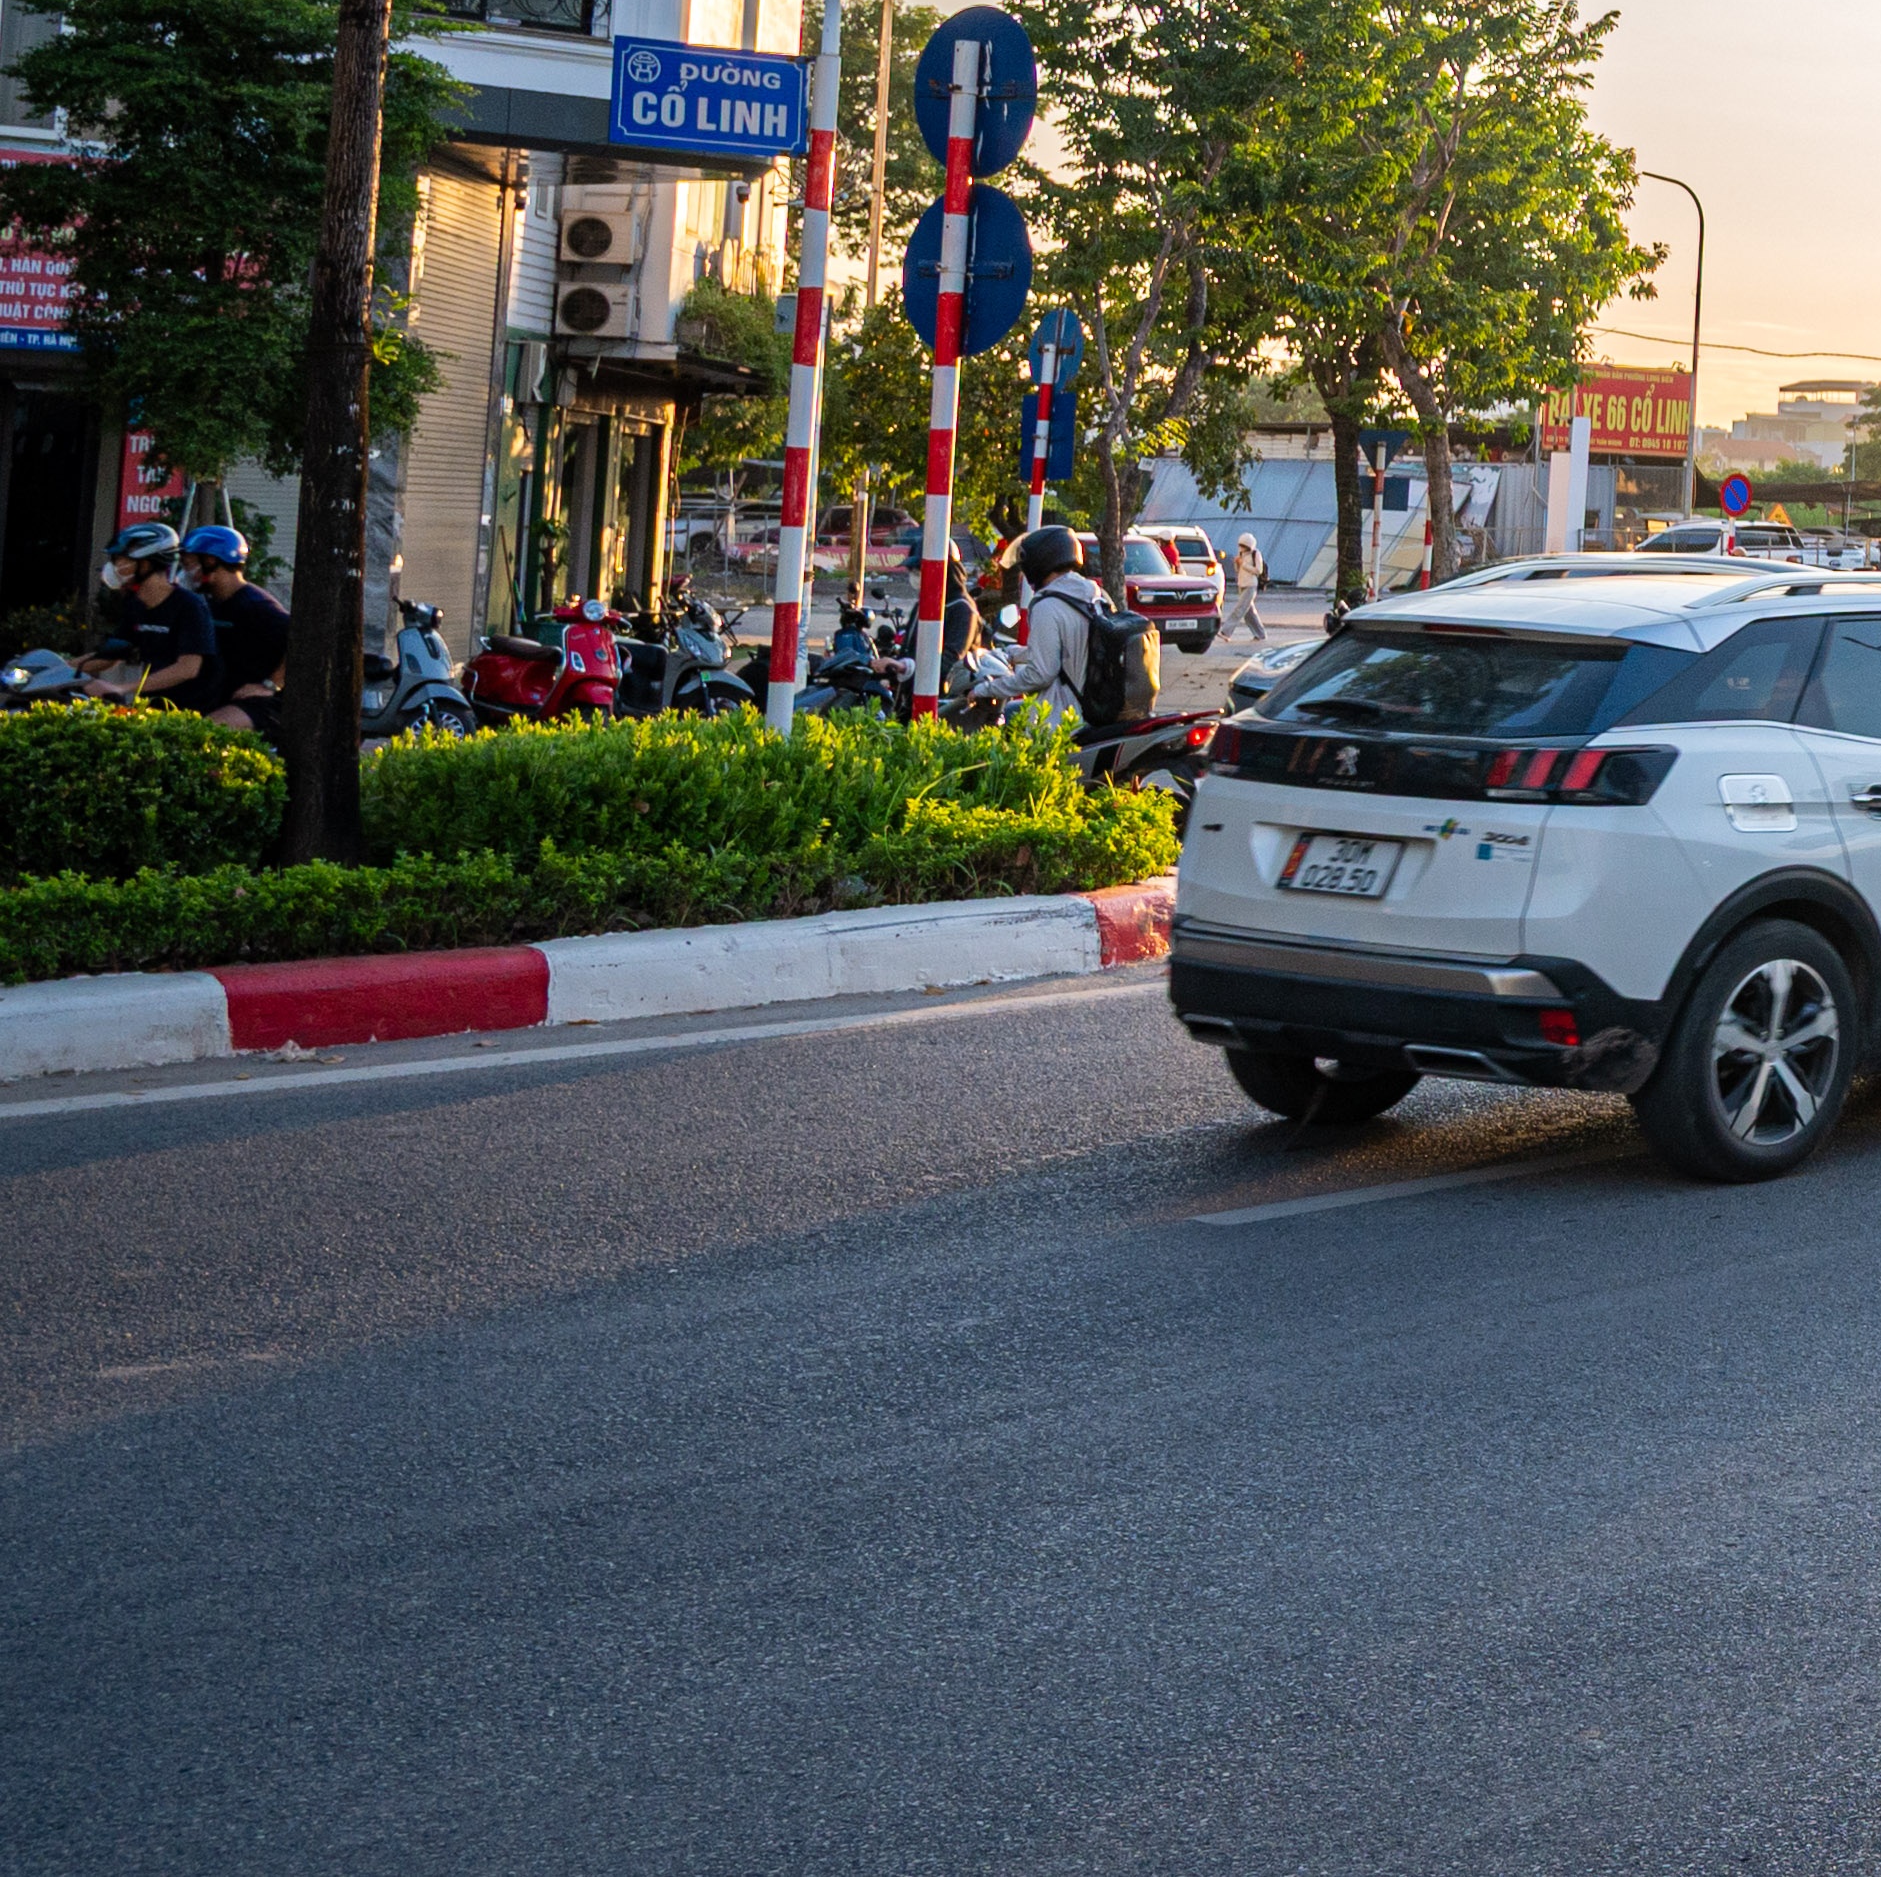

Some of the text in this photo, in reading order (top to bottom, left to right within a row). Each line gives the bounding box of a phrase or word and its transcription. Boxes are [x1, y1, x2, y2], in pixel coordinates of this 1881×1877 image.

[680, 61, 782, 90] ĐƯỜNG
[632, 81, 788, 138] CỔ LINH
[1582, 392, 1603, 430] XE
[1606, 394, 1627, 432] 66
[1630, 383, 1655, 434] CỔ
[1656, 398, 1690, 435] LINH
